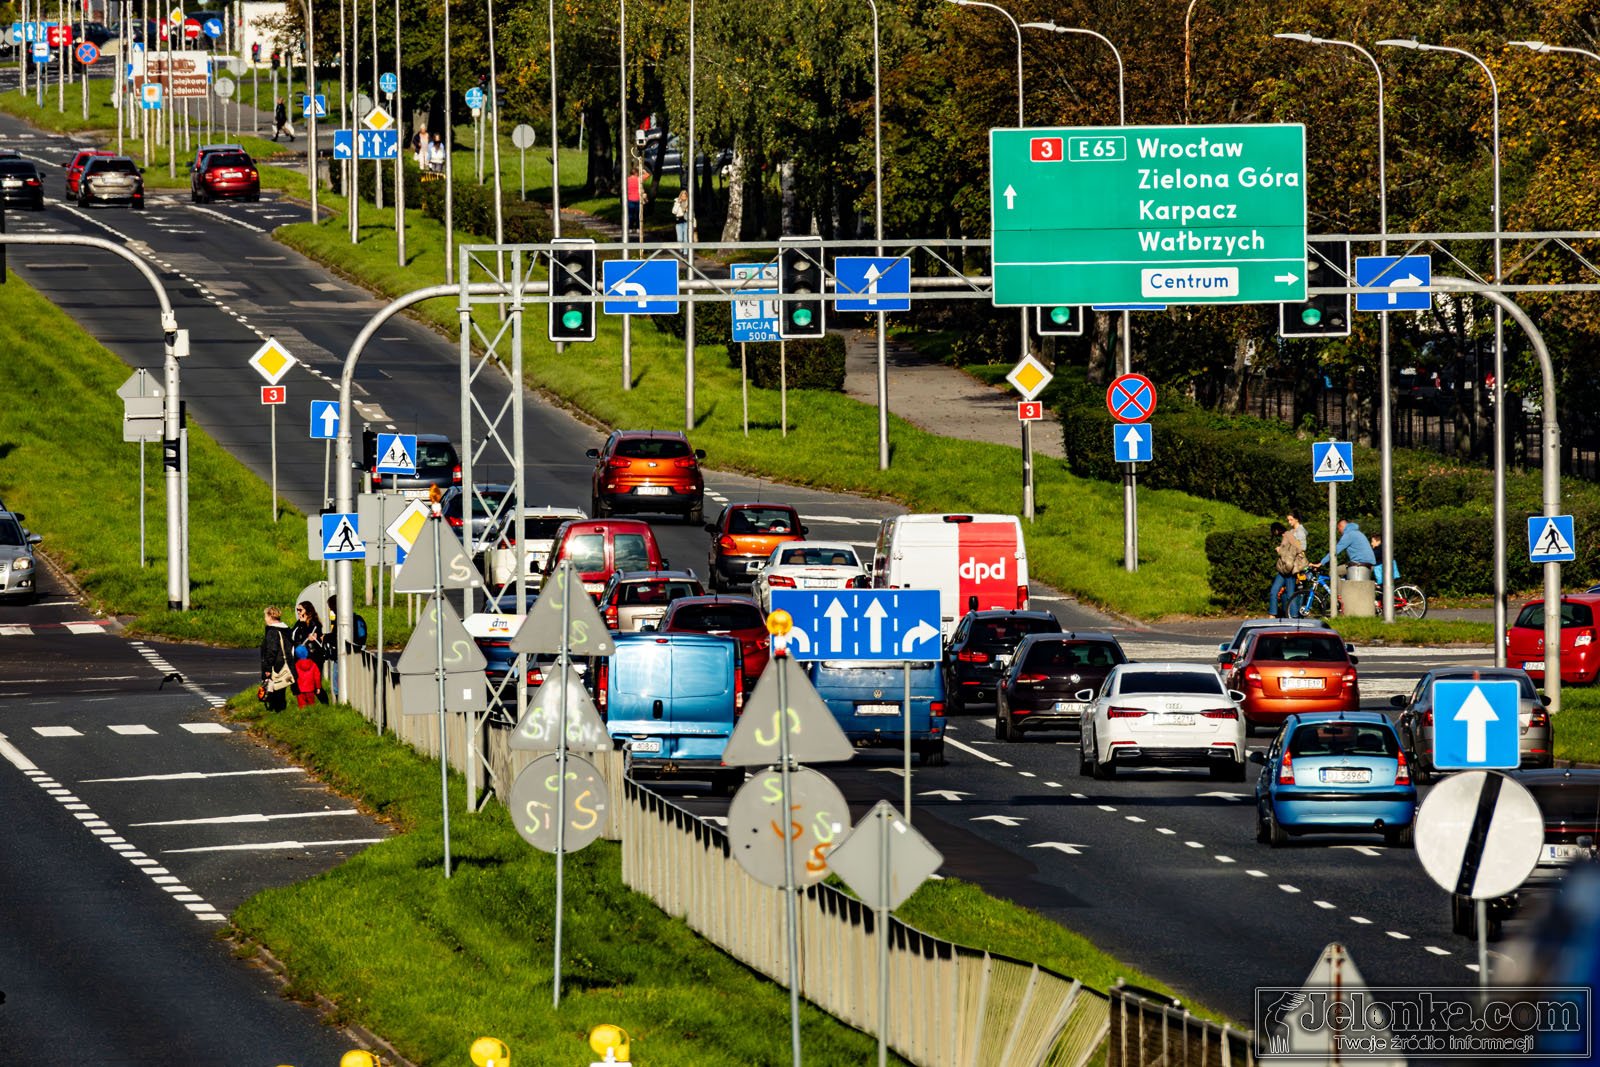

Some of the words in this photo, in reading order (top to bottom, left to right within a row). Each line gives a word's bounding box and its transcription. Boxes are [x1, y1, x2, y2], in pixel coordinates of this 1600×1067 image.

[1041, 141, 1053, 158] 3
[1136, 136, 1244, 159] Wrocław
[1138, 168, 1230, 190] Zielona
[1238, 166, 1300, 188] Góra
[1139, 199, 1238, 226] Karpacz
[1137, 229, 1265, 257] Wałbrzych
[1150, 273, 1230, 289] Centrum
[736, 321, 771, 331] STACJA
[748, 332, 767, 340] 500
[269, 389, 279, 401] 3
[1025, 405, 1035, 417] 3
[959, 556, 1006, 585] dpd
[491, 617, 508, 628] dm
